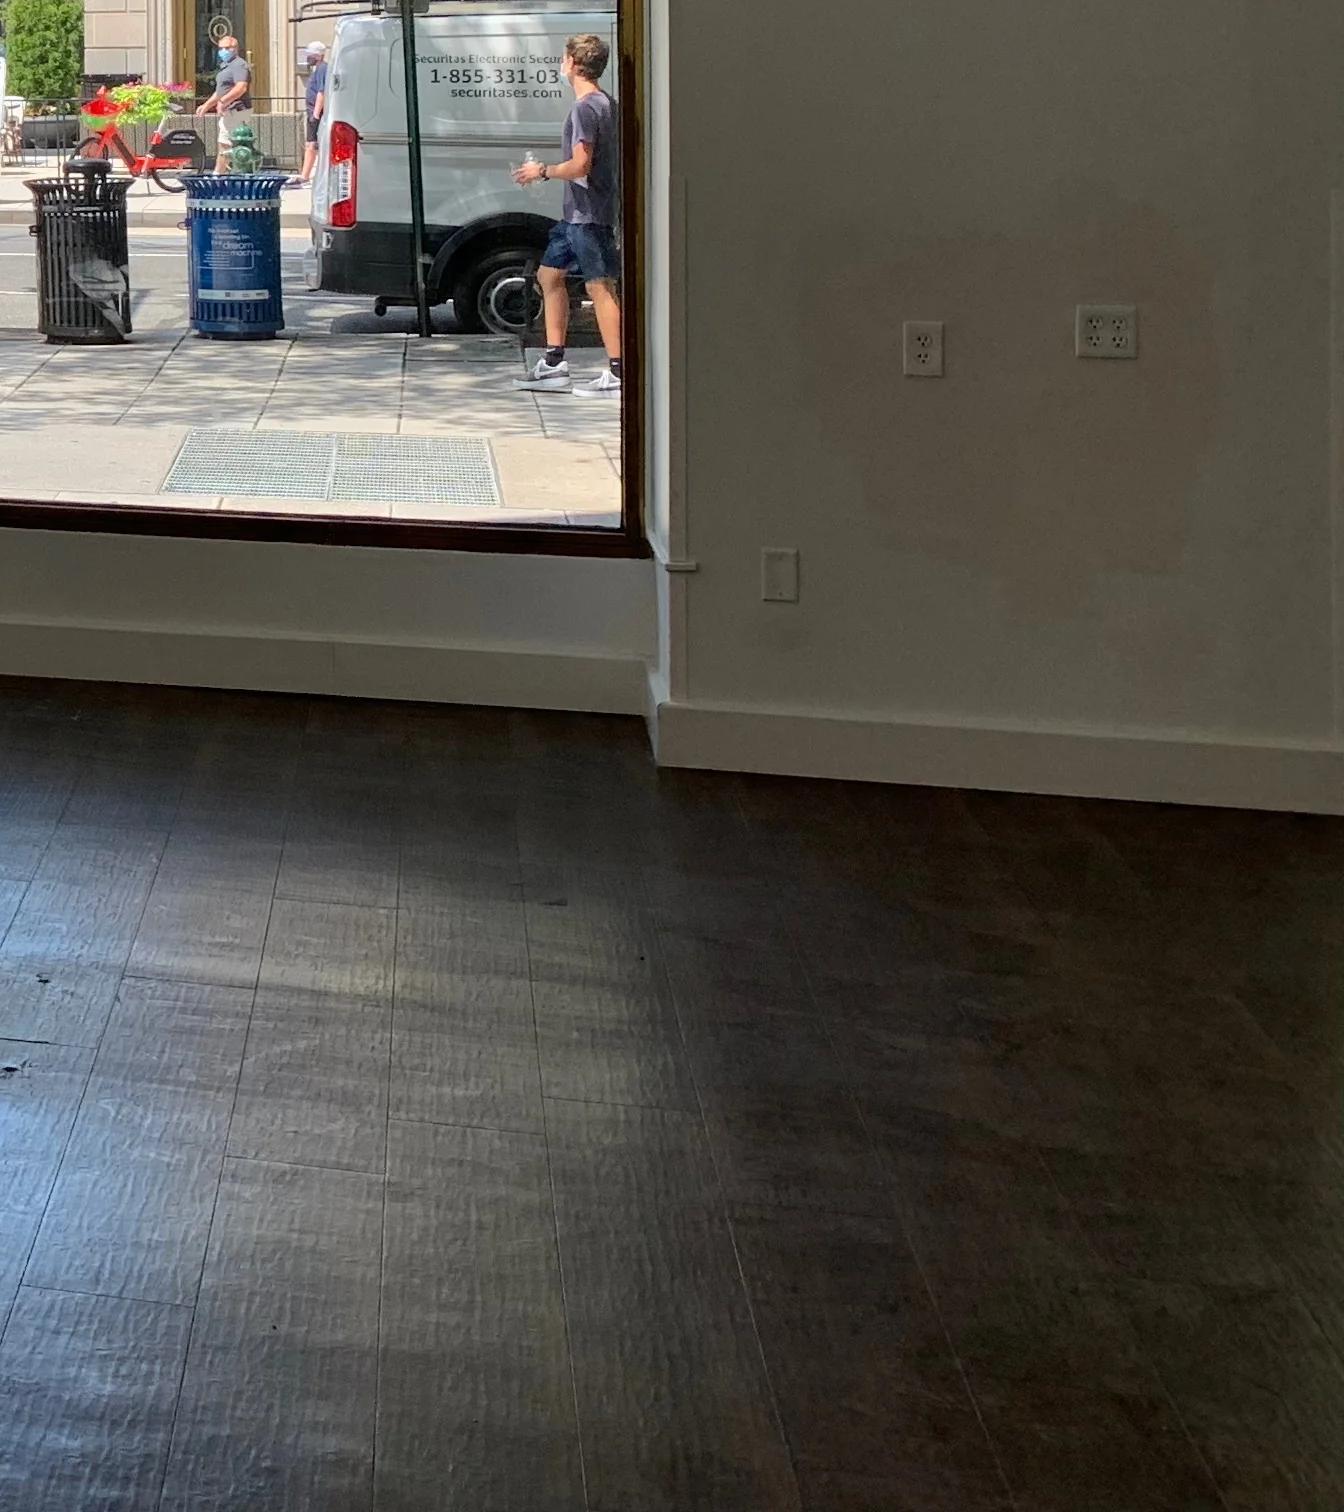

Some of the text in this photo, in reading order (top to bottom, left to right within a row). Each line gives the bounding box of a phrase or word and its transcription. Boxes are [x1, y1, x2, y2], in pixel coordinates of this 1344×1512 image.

[415, 54, 563, 64] Securitas Electronic Secur
[430, 69, 562, 84] 1-855-331-03
[451, 88, 562, 99] securitases.com
